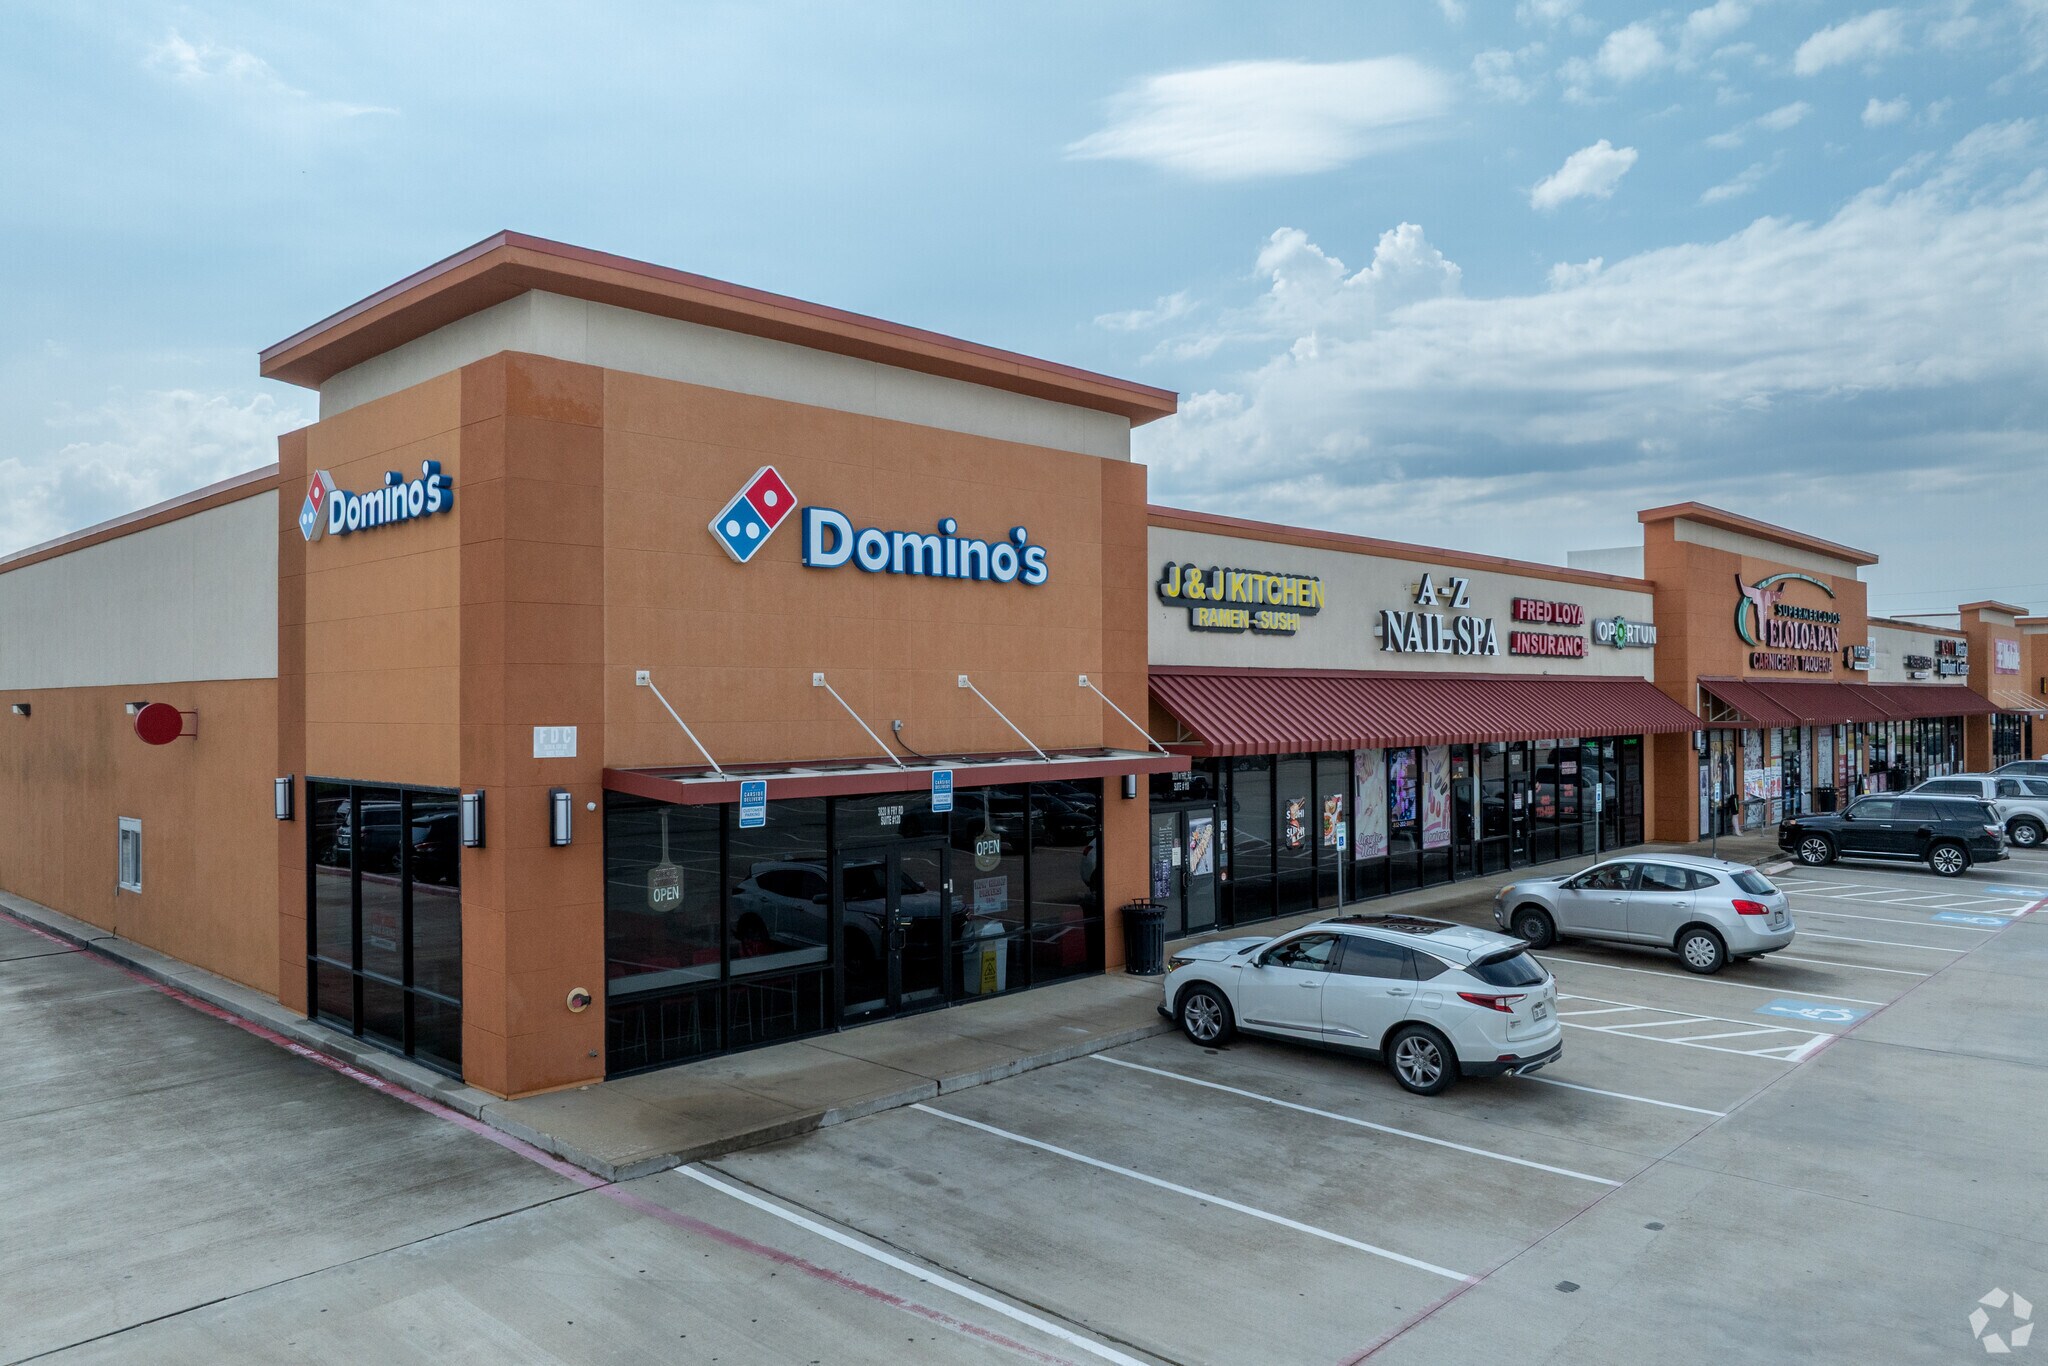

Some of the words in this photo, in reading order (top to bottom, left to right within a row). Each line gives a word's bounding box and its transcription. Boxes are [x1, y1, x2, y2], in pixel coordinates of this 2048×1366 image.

[329, 460, 453, 535] Domino's
[802, 506, 1049, 585] Domino's
[1161, 566, 1181, 598] J
[1184, 568, 1206, 599] &
[1206, 570, 1225, 601] J
[1227, 571, 1325, 608] KITCHEN
[1517, 599, 1552, 622] FRED
[1555, 602, 1585, 624] LOYA
[1381, 610, 1453, 653] NAIL
[1454, 616, 1500, 656] SPA
[1516, 632, 1589, 657] INSURANCE
[976, 839, 1000, 856] OPEN
[653, 886, 679, 902] OPEN
